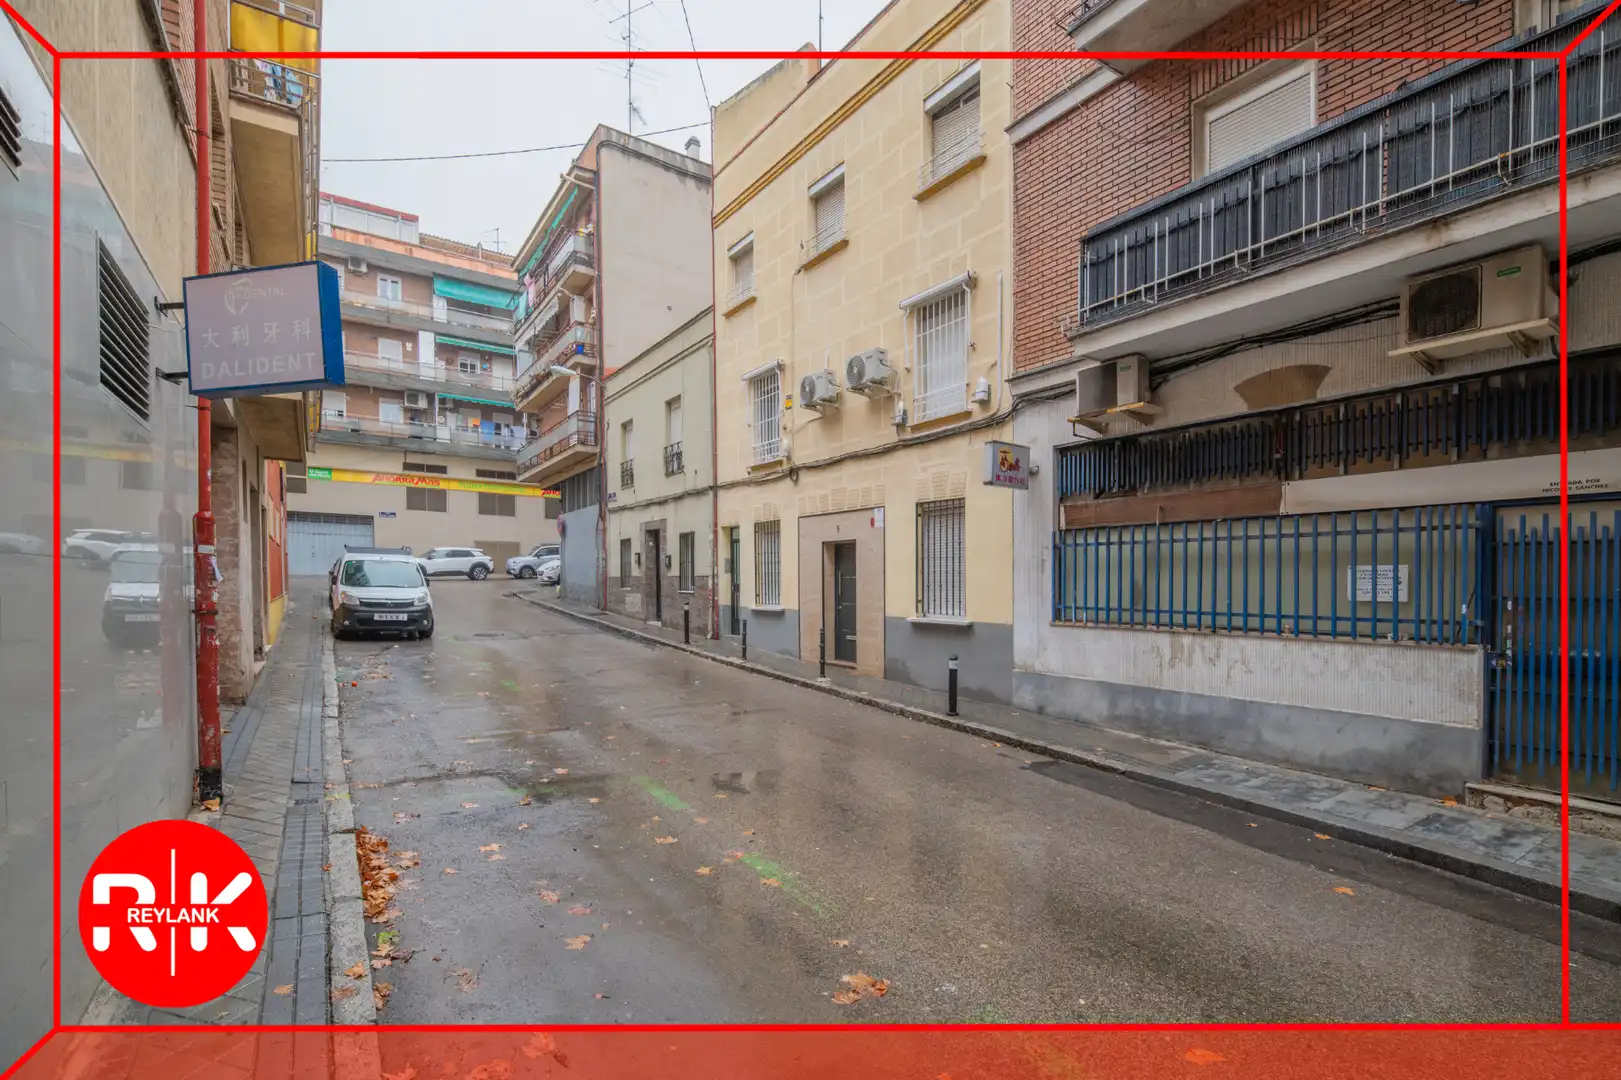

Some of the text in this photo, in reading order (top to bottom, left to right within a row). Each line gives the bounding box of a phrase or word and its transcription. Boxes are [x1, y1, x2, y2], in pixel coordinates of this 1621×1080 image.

[201, 317, 312, 349] 大利牙科
[202, 352, 316, 380] DALIDENT
